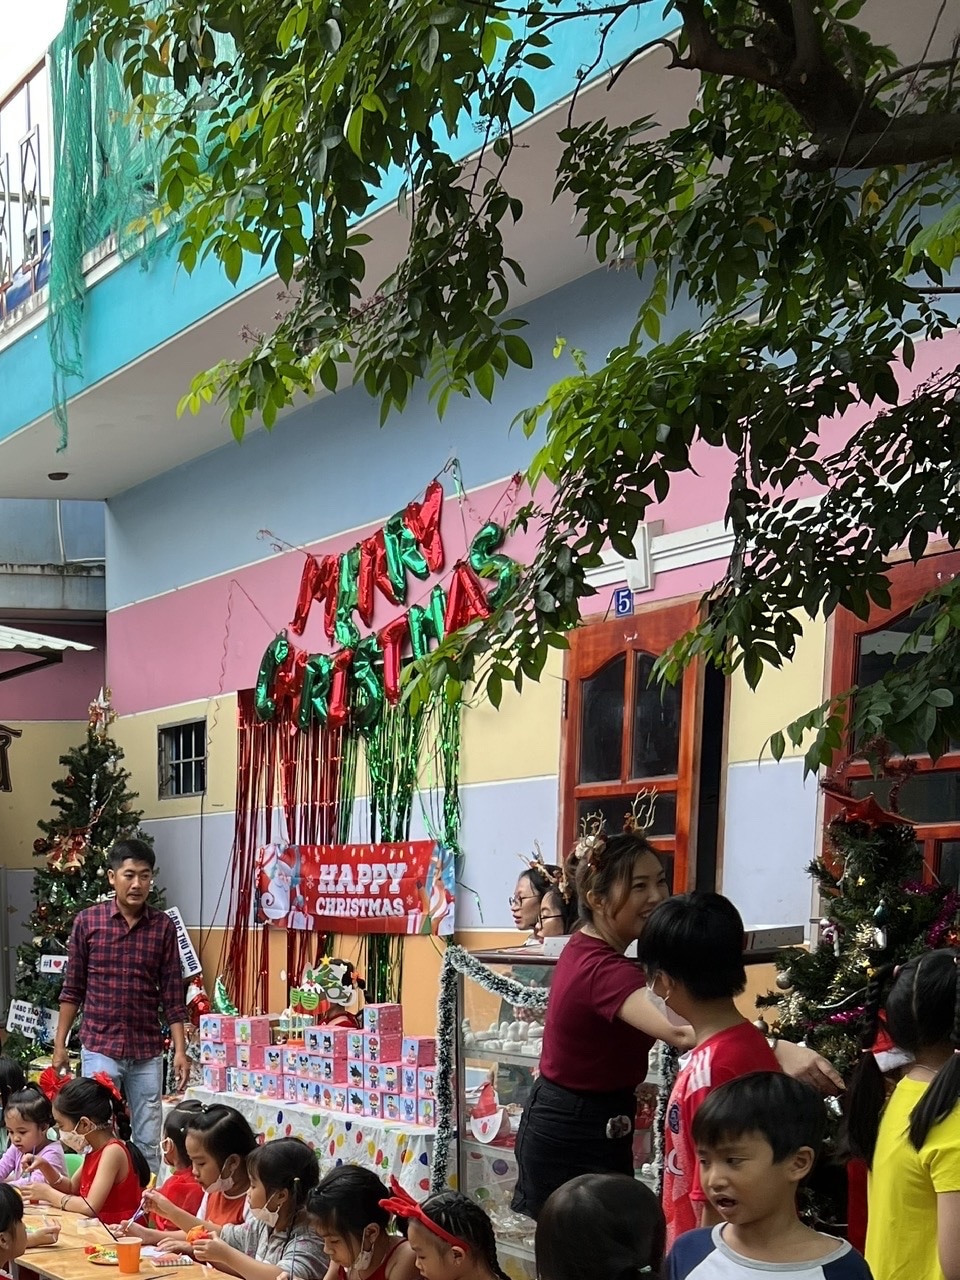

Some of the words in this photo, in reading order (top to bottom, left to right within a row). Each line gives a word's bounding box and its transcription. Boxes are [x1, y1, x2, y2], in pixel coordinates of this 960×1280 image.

[619, 590, 631, 613] 5
[317, 862, 408, 894] HAPPY
[315, 897, 404, 917] CHRISTMAS
